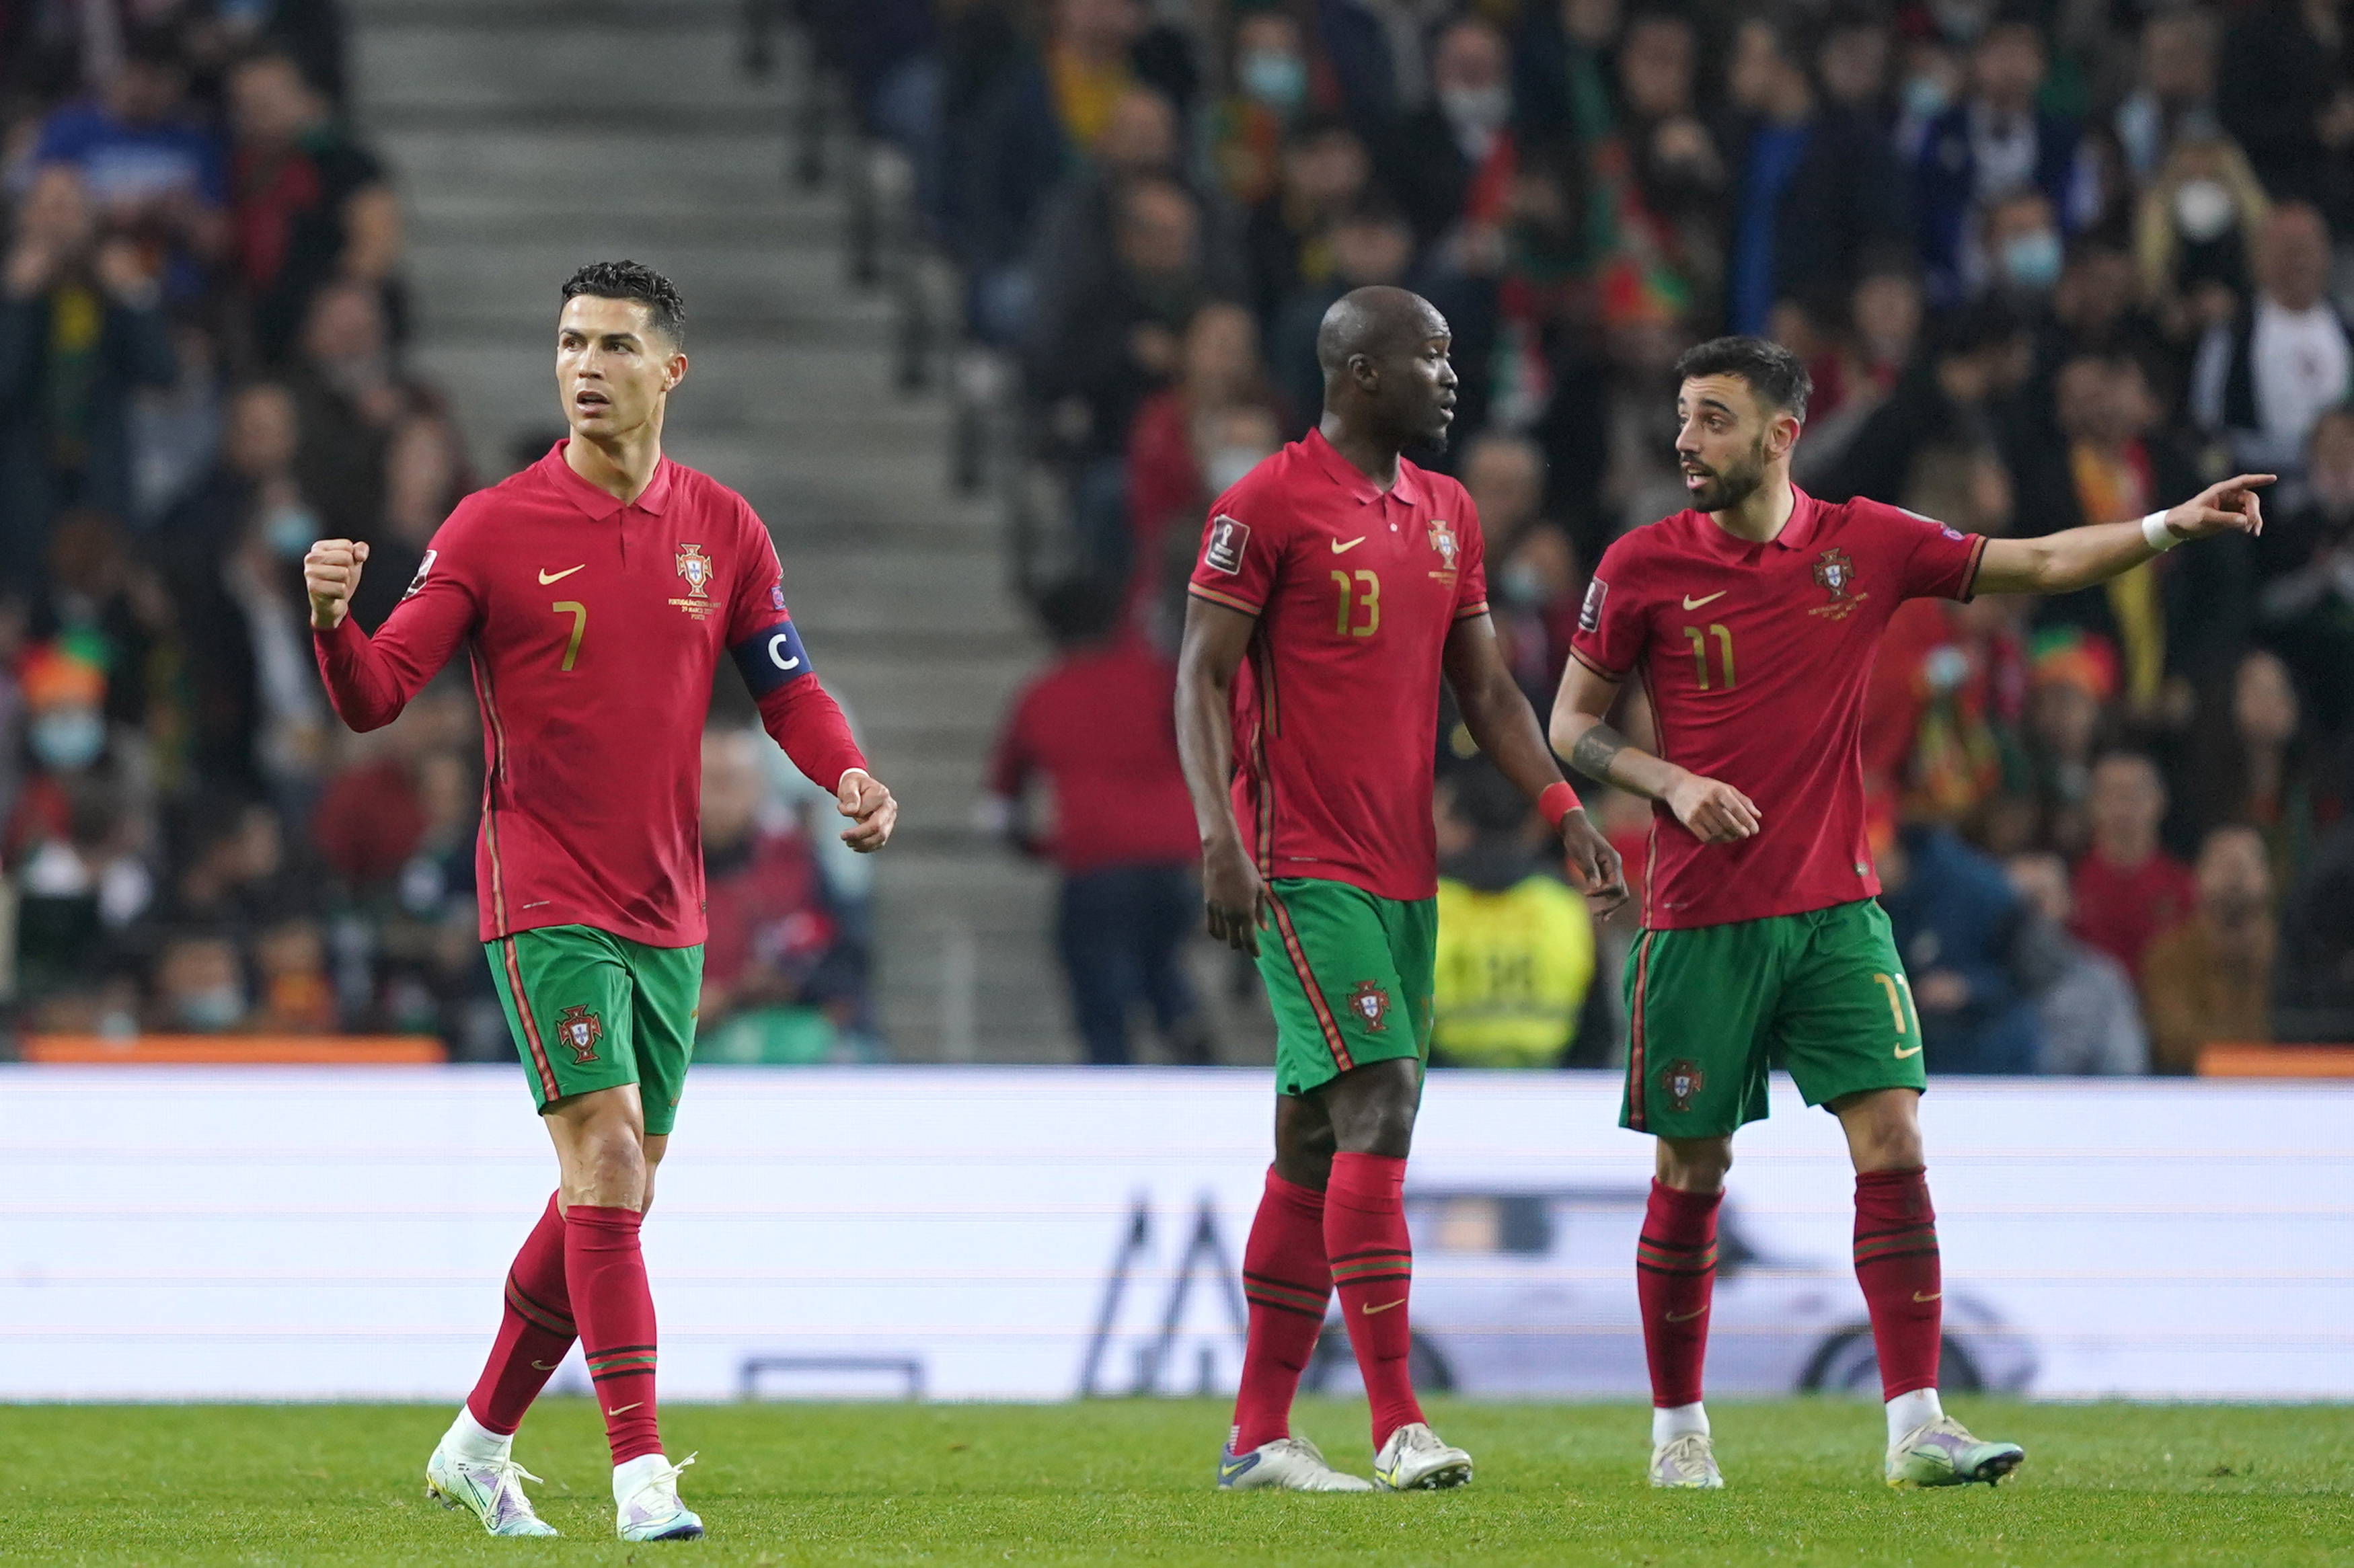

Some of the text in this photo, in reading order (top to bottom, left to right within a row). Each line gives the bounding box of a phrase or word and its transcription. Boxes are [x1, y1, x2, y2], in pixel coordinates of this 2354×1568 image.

[552, 600, 587, 672] 7
[1330, 569, 1380, 637] 13
[768, 633, 800, 670] C
[1683, 623, 1735, 691] 11
[1873, 973, 1922, 1038] 11
